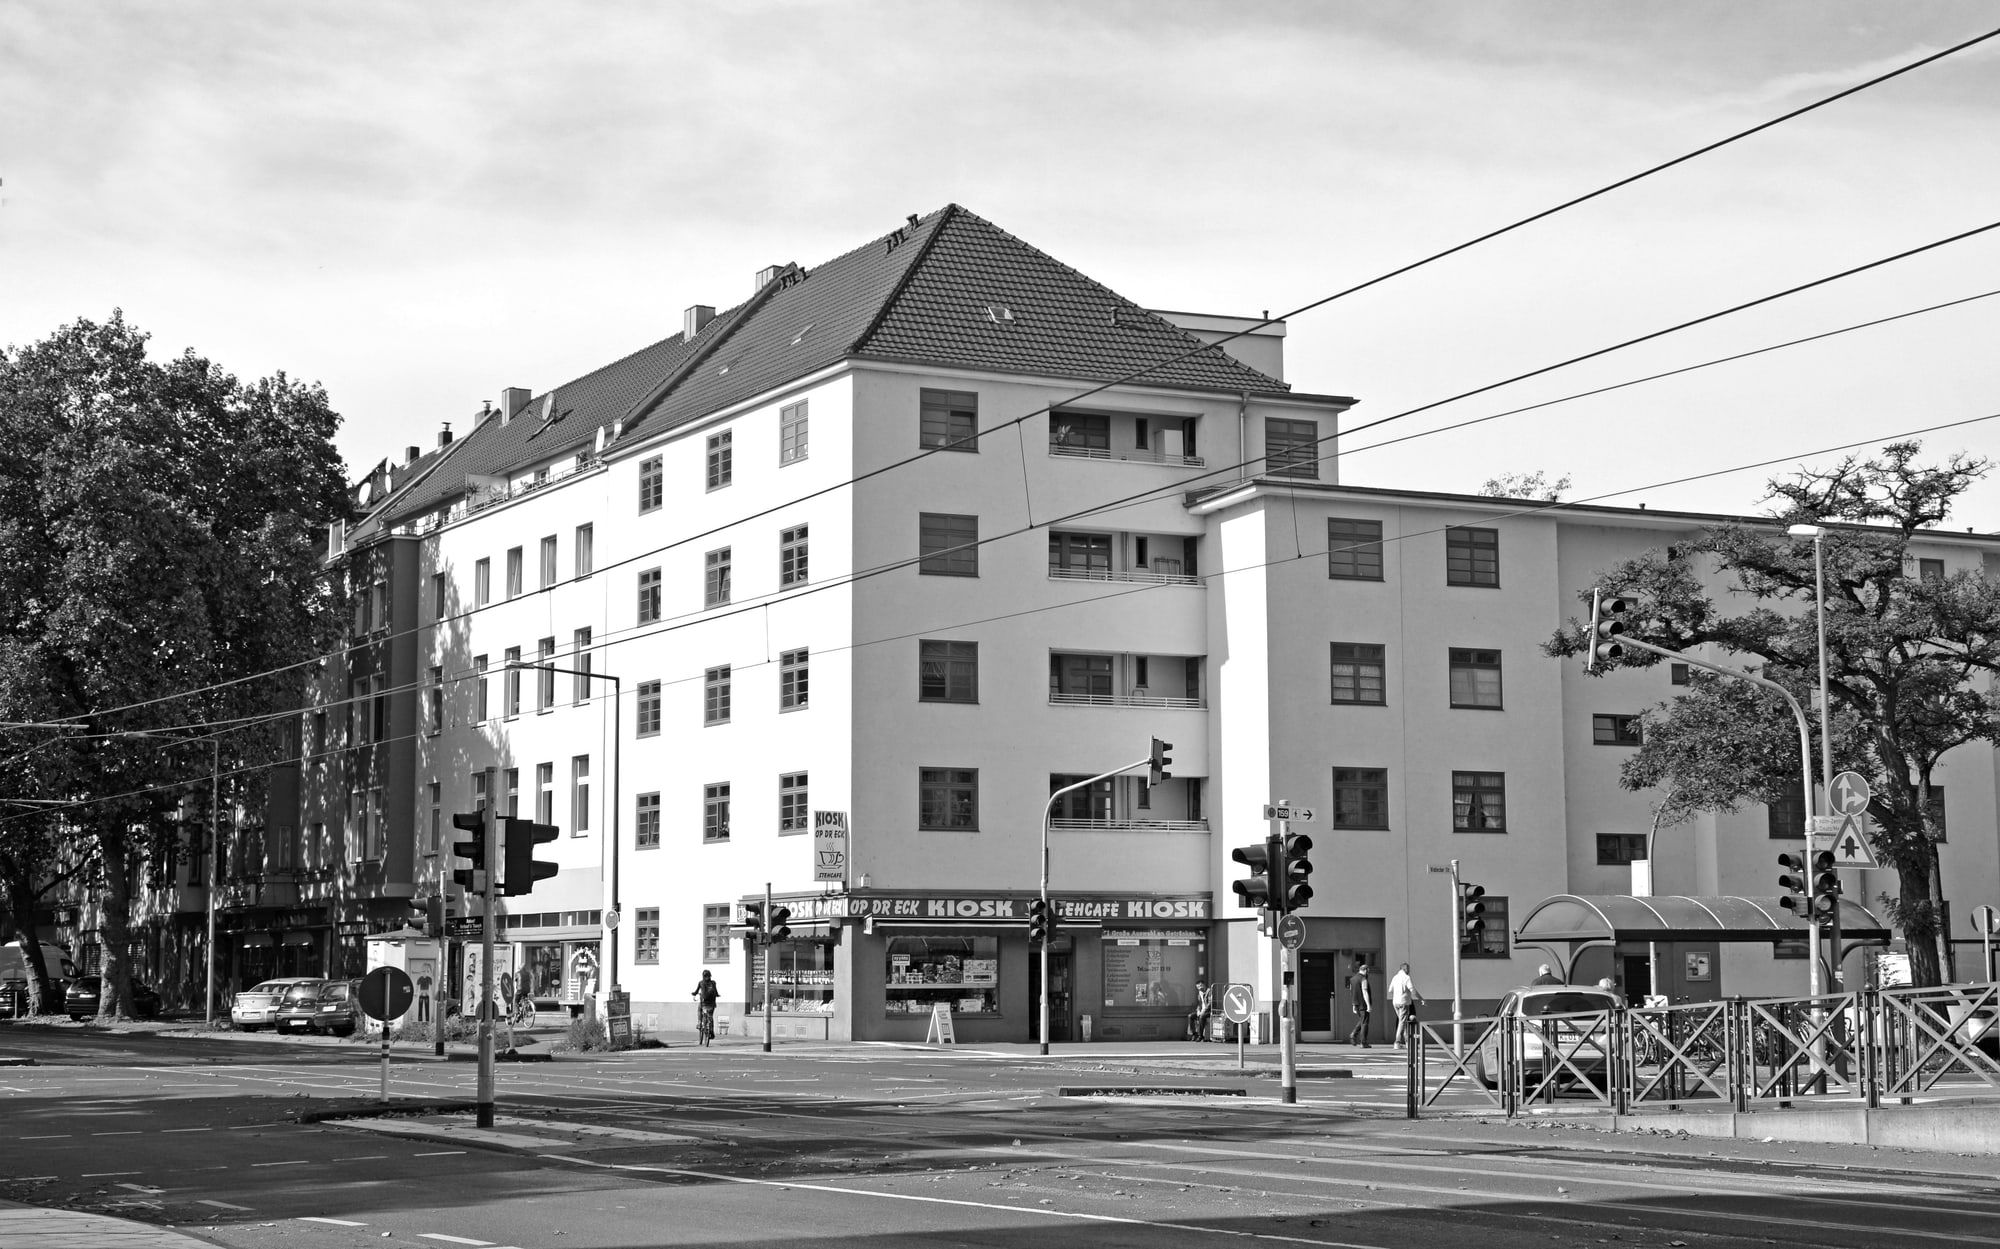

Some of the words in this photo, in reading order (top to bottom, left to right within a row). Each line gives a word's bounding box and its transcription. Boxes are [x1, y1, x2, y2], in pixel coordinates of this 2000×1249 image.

[815, 811, 844, 829] KIOSK
[815, 830, 823, 838] OP
[825, 830, 833, 839] DR
[834, 830, 845, 839] ECK
[850, 899, 868, 915] OP
[895, 900, 920, 915] ECK
[927, 900, 1013, 917] KIOSK
[1127, 901, 1204, 918] KIOSK
